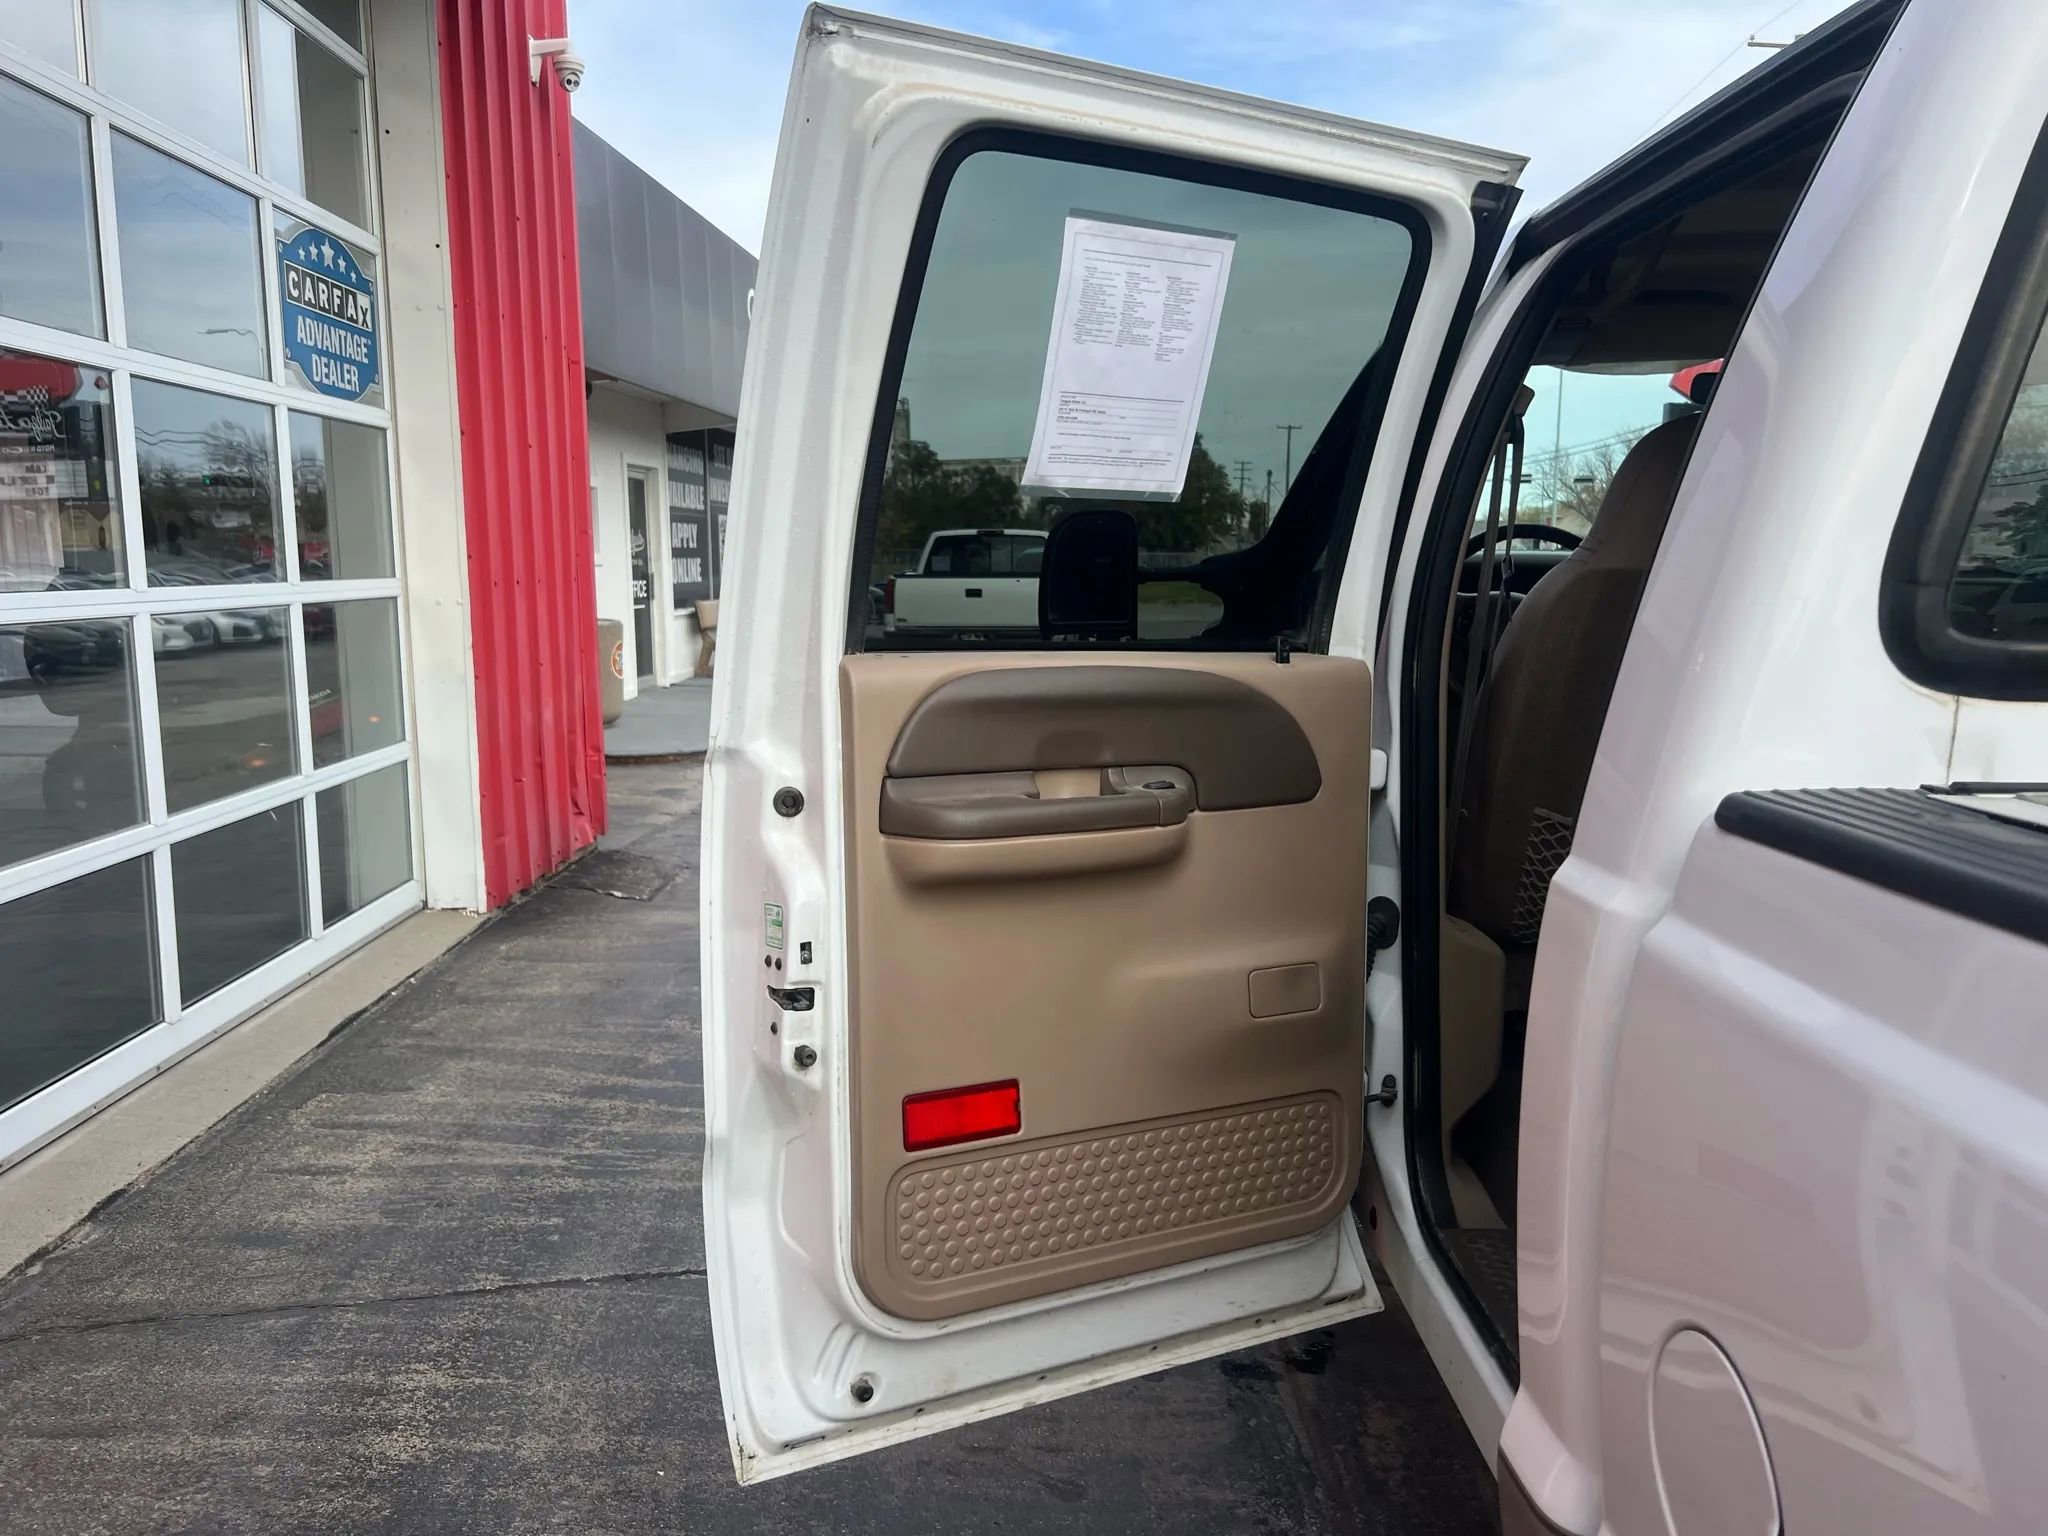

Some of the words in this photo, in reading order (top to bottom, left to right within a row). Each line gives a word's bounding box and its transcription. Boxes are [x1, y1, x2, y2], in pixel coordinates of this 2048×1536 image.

[288, 270, 370, 329] CARFAX
[297, 315, 369, 364] ADVANTAGE
[312, 353, 360, 393] DEALER
[672, 522, 698, 548] APPLY
[671, 558, 702, 585] ONLINE
